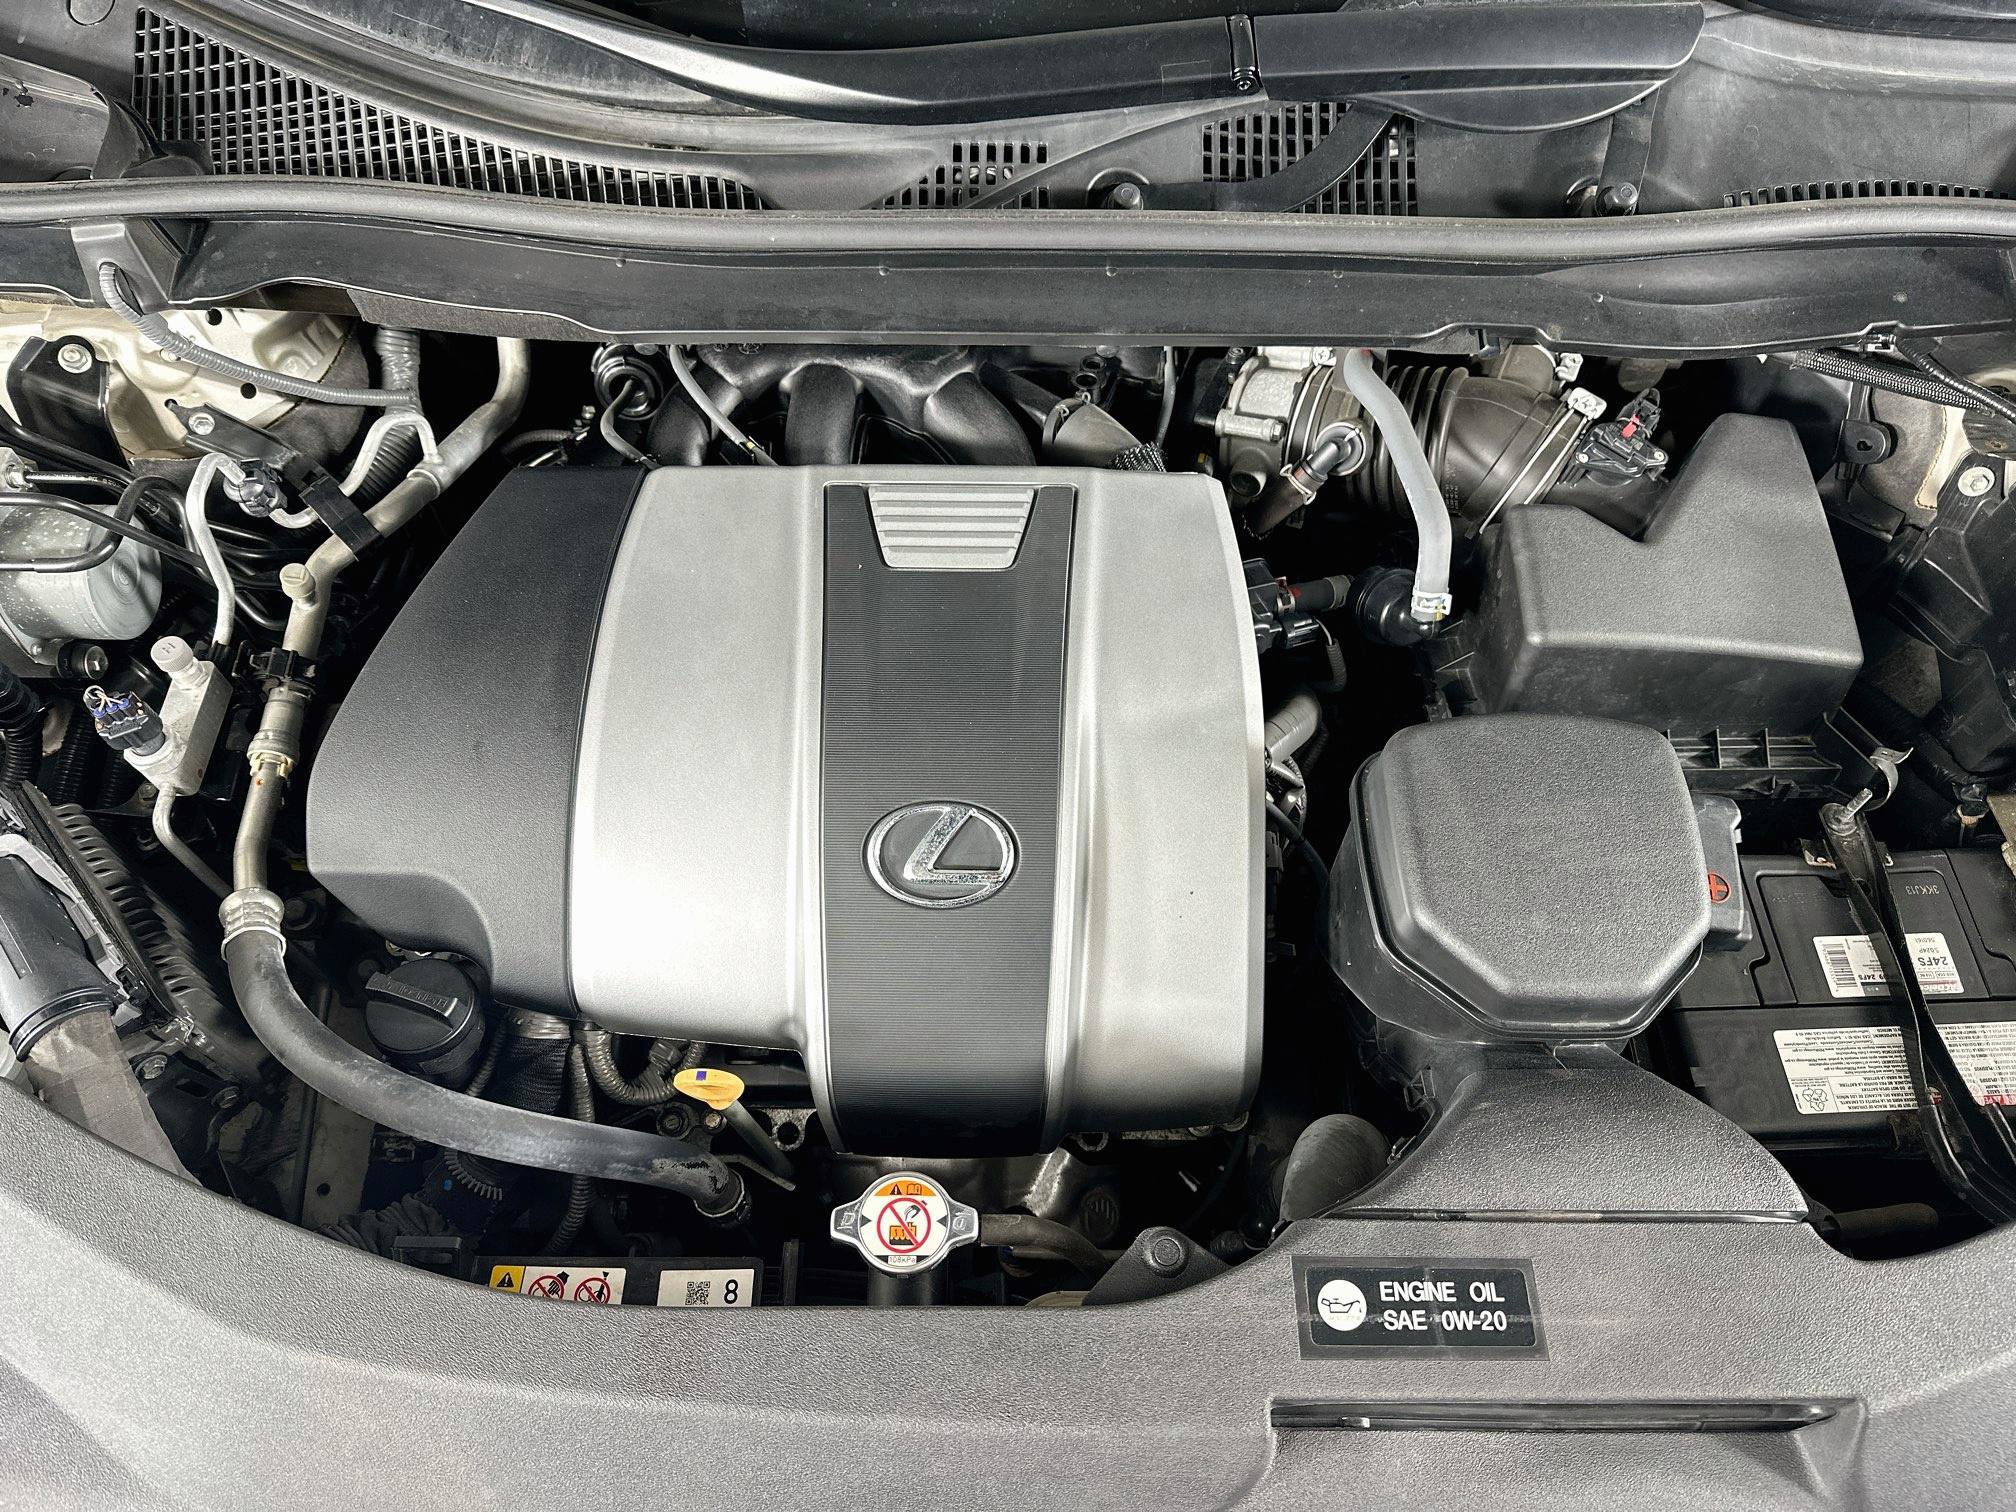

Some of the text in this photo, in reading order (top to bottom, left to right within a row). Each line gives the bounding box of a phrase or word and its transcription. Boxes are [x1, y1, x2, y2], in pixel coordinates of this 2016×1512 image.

[1906, 885, 1939, 894] 3KKJ13
[1918, 956, 1948, 966] 24FS
[724, 1279, 738, 1304] 8
[1380, 1282, 1505, 1302] ENGINE OIL
[1383, 1310, 1507, 1331] SAE 0W-20
